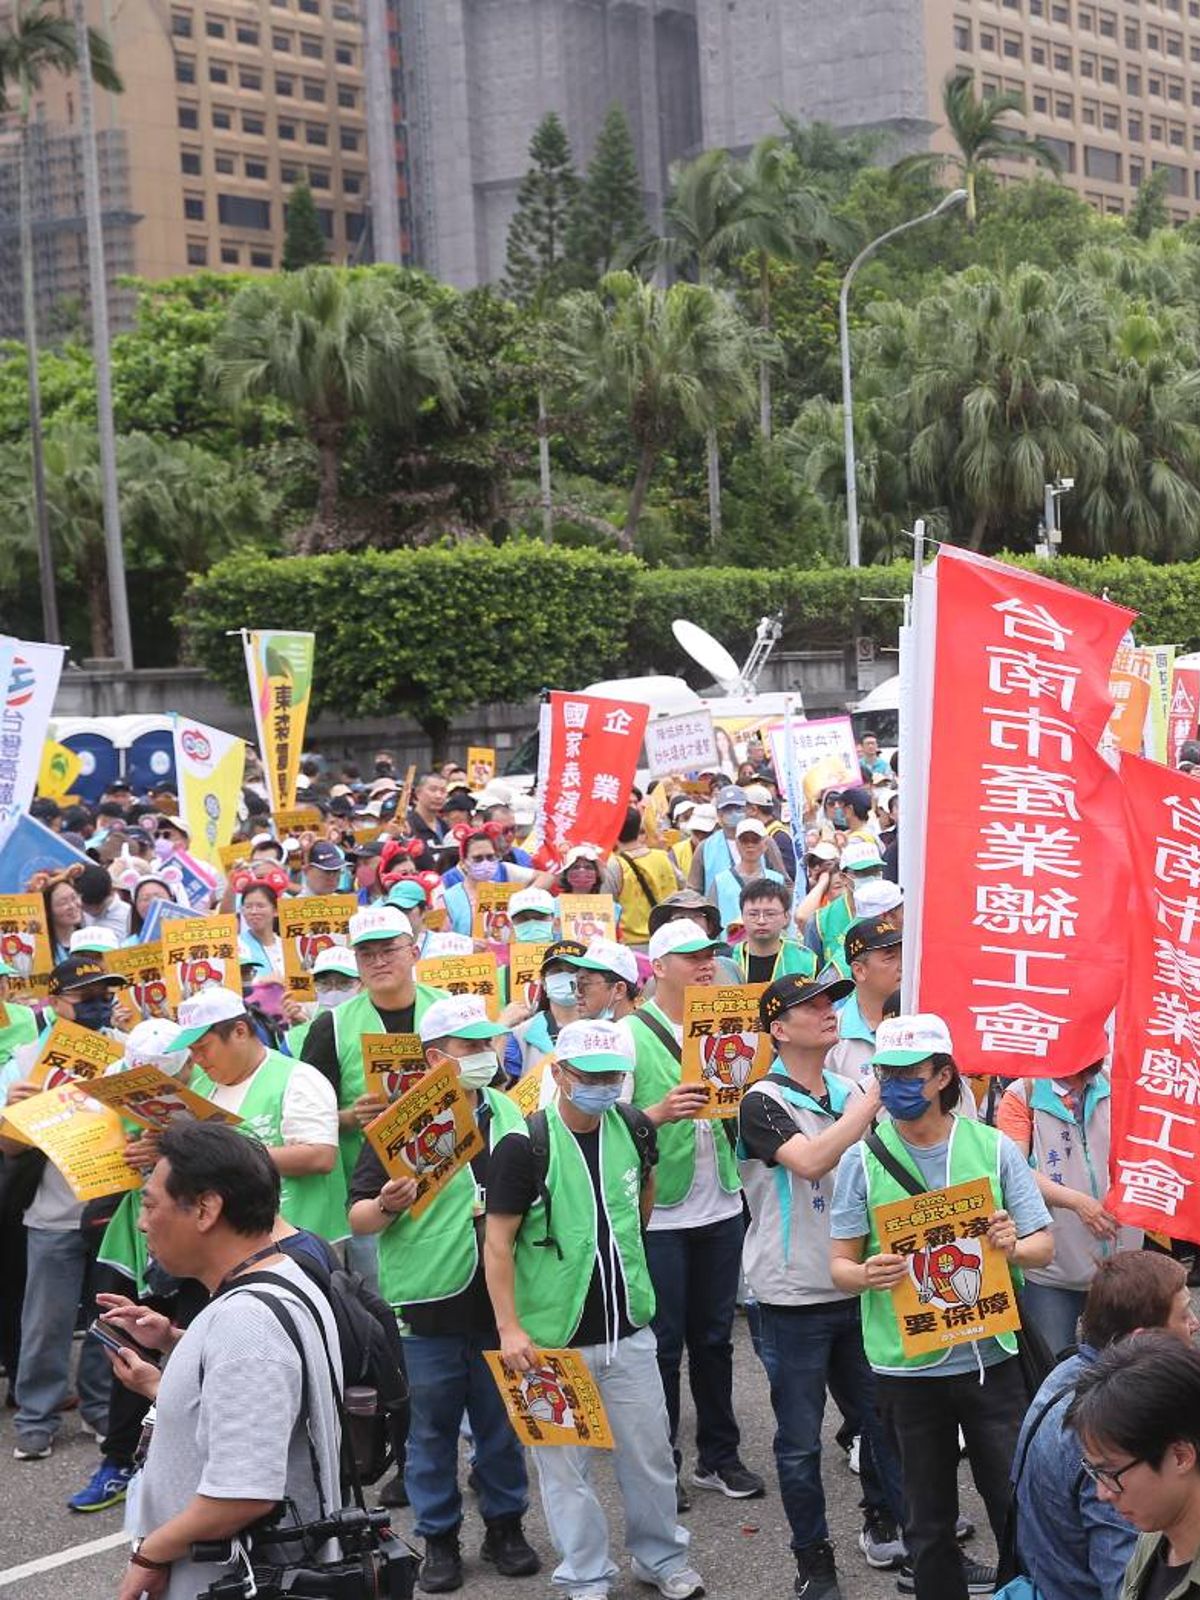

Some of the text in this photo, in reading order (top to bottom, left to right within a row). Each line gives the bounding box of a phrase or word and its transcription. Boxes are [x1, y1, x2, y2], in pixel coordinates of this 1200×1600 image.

[591, 708, 634, 805] 企業
[168, 944, 234, 965] 反霸凌
[432, 980, 495, 996] 霸凌
[385, 1089, 460, 1161] 反霸凌
[885, 1194, 985, 1233] 五一勞工大遊行
[890, 1216, 991, 1256] 反霸凌
[903, 1291, 1011, 1336] 要保障
